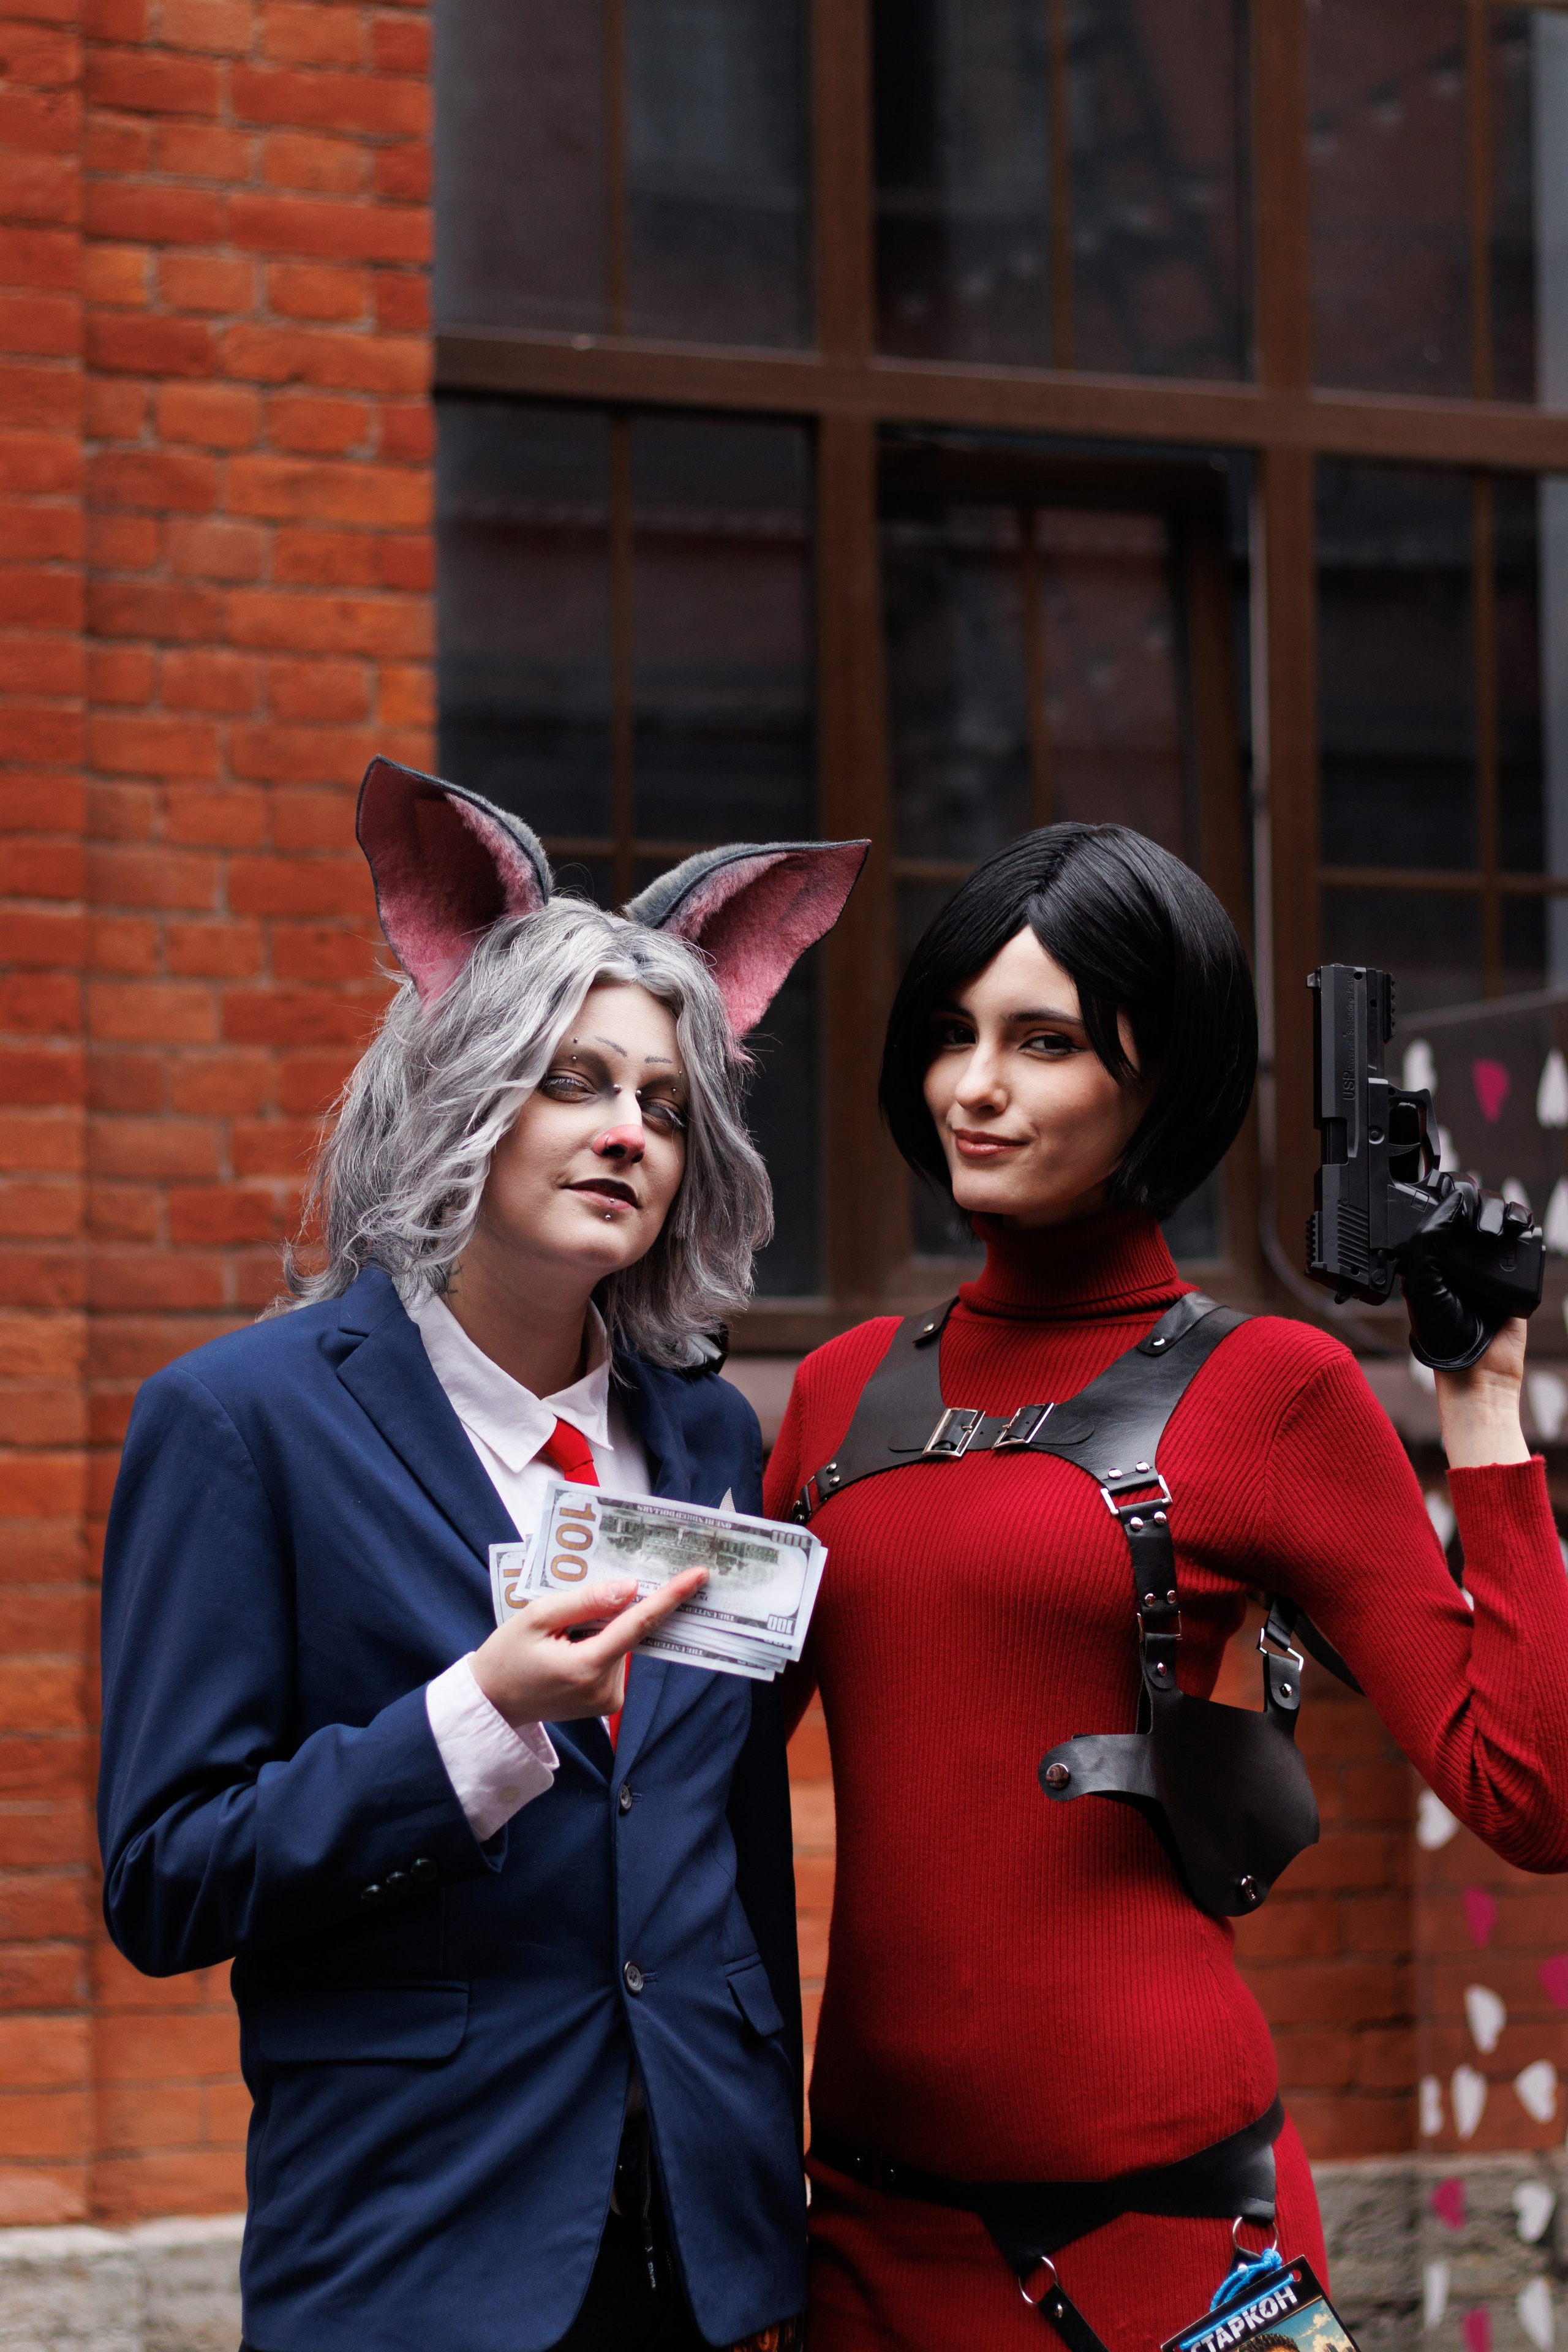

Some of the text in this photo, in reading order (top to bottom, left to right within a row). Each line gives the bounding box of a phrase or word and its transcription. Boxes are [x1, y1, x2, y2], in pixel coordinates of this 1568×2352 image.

[1346, 973, 1354, 993] Pistol
[1346, 1039, 1355, 1071] Universal
[1342, 1071, 1355, 1101] USP
[636, 1504, 674, 1517] DOLLARS
[551, 1502, 597, 1582] 100
[767, 1615, 794, 1635] 100
